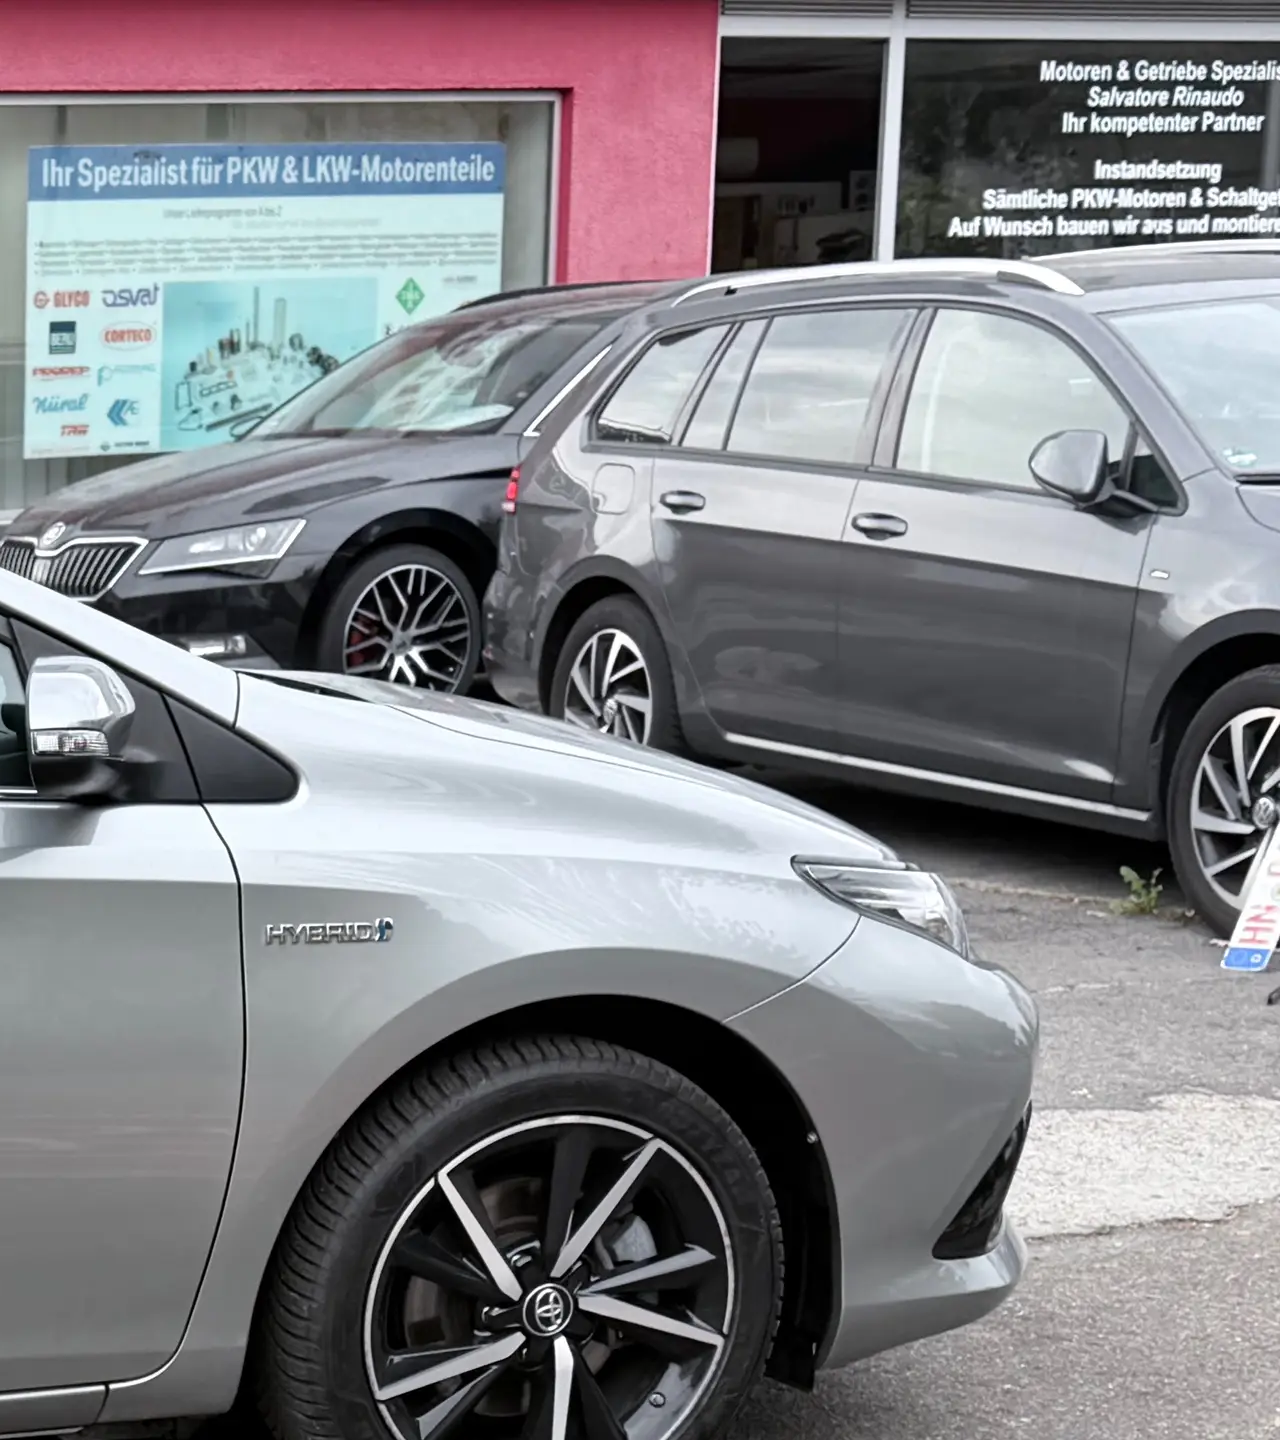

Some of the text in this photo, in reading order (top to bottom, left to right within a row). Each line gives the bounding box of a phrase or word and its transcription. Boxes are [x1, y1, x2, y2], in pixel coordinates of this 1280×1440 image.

[1040, 59, 1112, 82] Motoren
[1116, 60, 1131, 82] &
[1135, 59, 1207, 82] Getriebe
[1087, 85, 1244, 108] Salvatore Rinaudo
[1061, 110, 1265, 137] Ihr kompetenter Partner
[42, 154, 495, 193] Ihr Spezialist für PKW & LKW-Motorenteile
[1094, 159, 1222, 184] Instandsetzung
[982, 186, 1280, 211] Sämtliche PKW-Motoren & Schaltge
[947, 215, 981, 237] Auf
[983, 215, 1053, 237] Wunsch
[1056, 214, 1109, 236] bauen
[1112, 214, 1140, 235] wir
[1176, 213, 1210, 234] und
[264, 922, 374, 946] HYBRID
